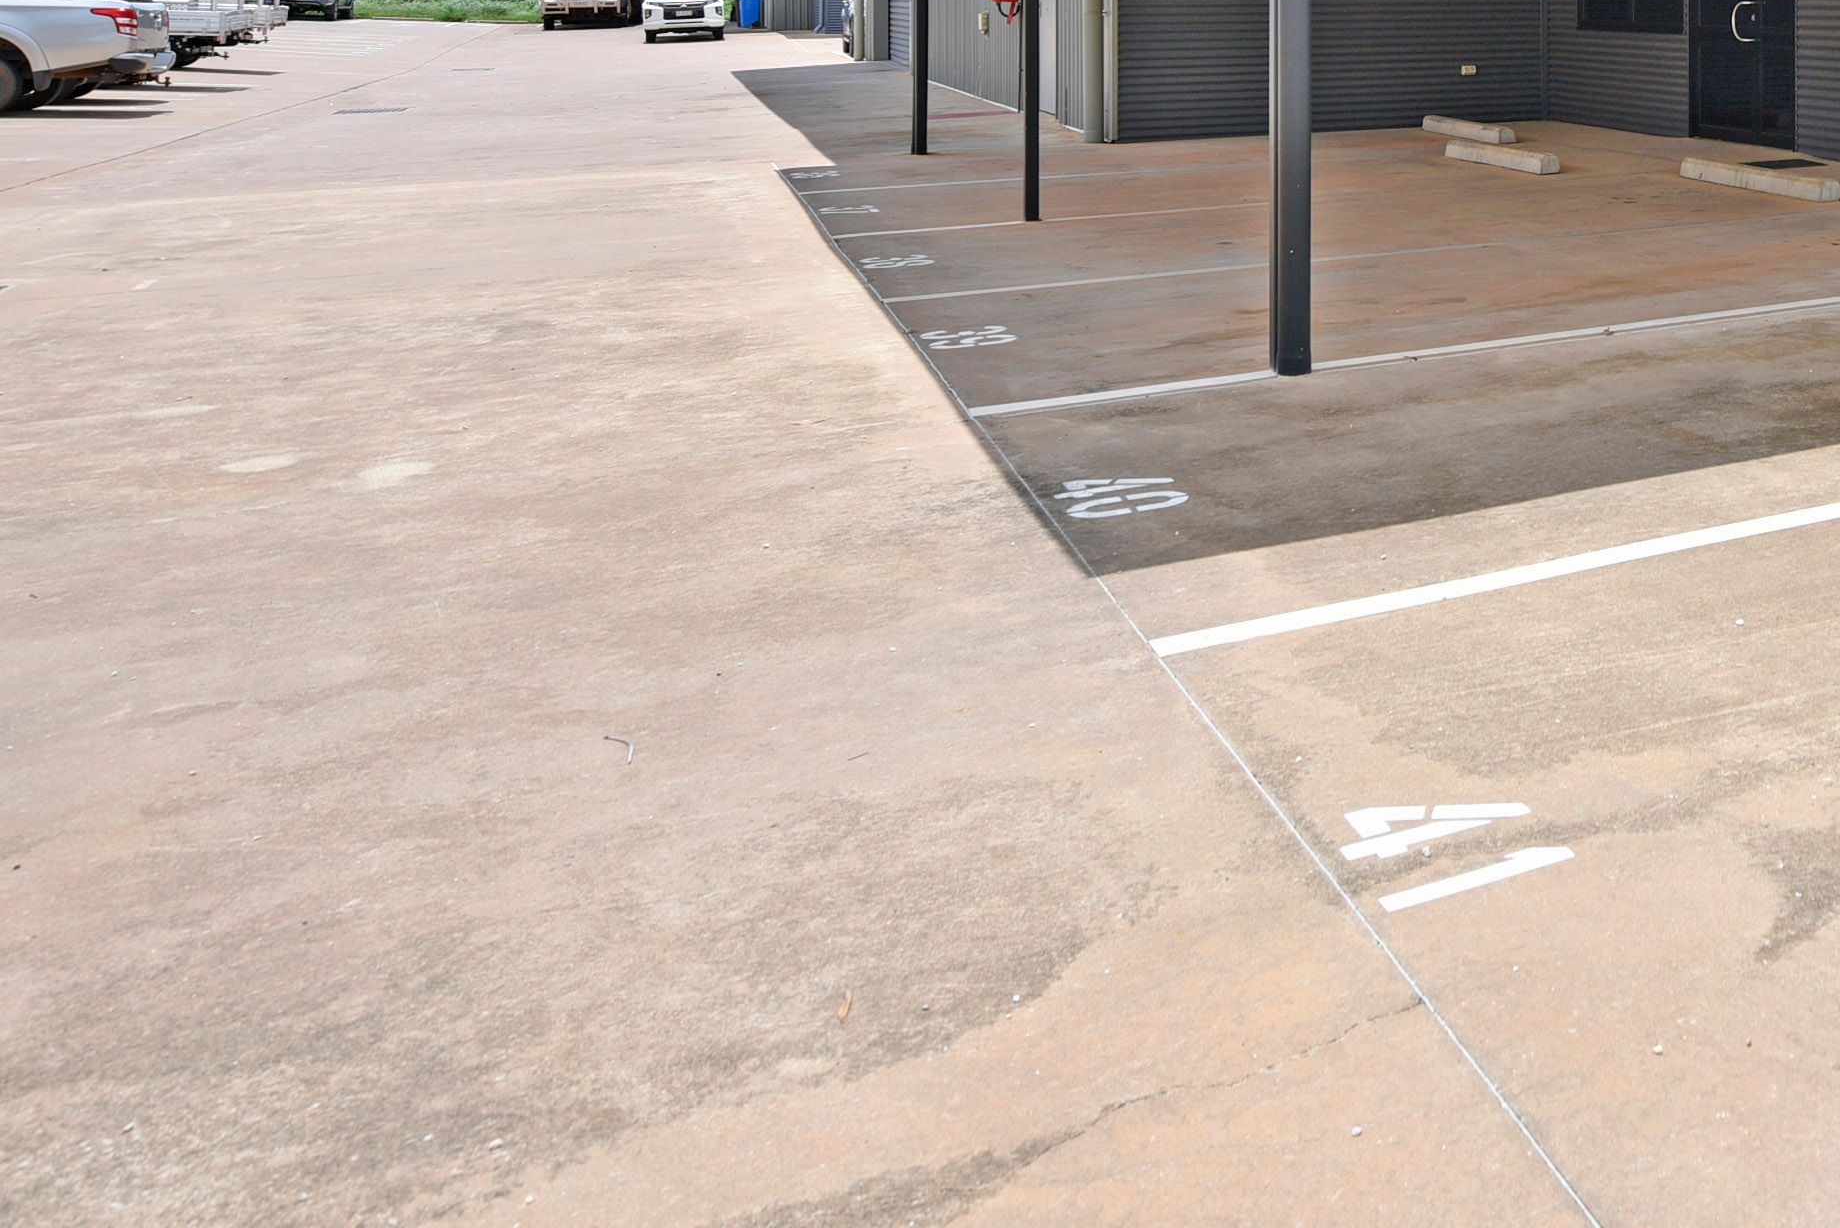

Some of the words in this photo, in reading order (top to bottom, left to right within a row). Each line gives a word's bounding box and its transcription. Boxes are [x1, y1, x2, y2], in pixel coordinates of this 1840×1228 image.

[818, 204, 880, 215] 37
[859, 254, 936, 269] 38
[919, 325, 1018, 350] 39
[1053, 477, 1190, 518] 40
[1340, 802, 1575, 913] 41
